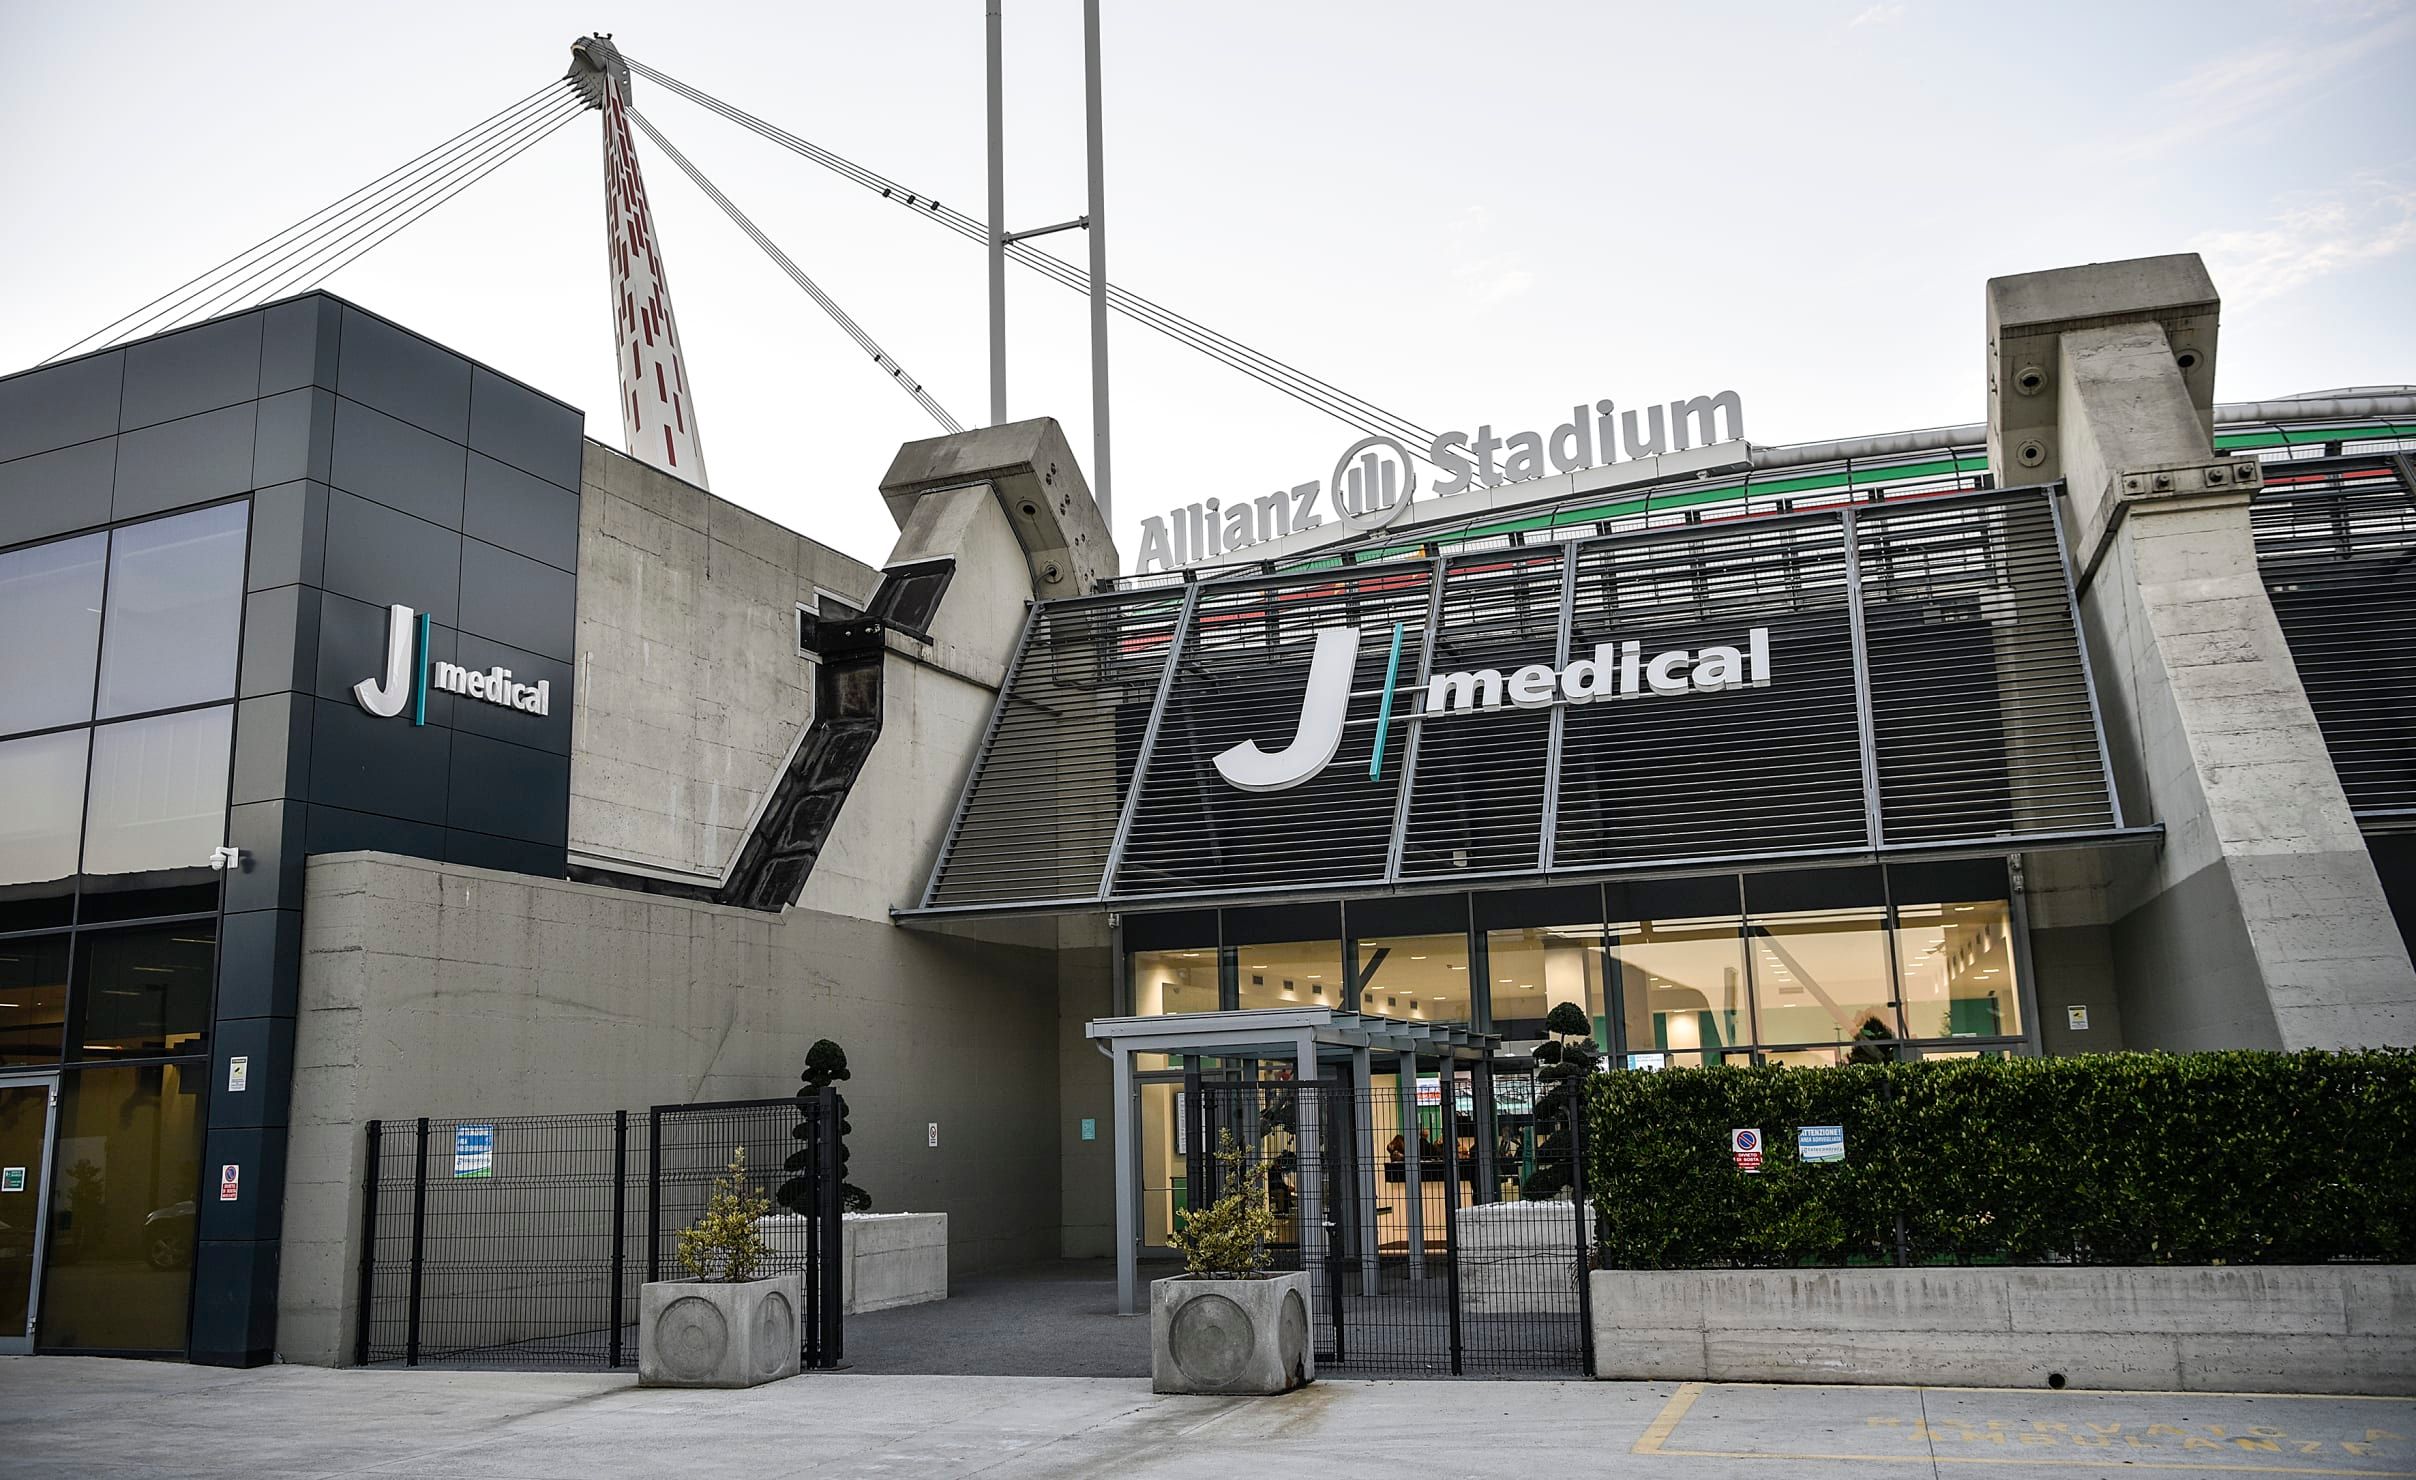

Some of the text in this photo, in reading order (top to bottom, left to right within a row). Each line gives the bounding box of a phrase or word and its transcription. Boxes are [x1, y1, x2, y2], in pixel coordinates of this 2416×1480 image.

[1136, 389, 1745, 574] Allianz Stadium
[354, 604, 550, 717] J medical
[1212, 627, 1770, 792] J medical
